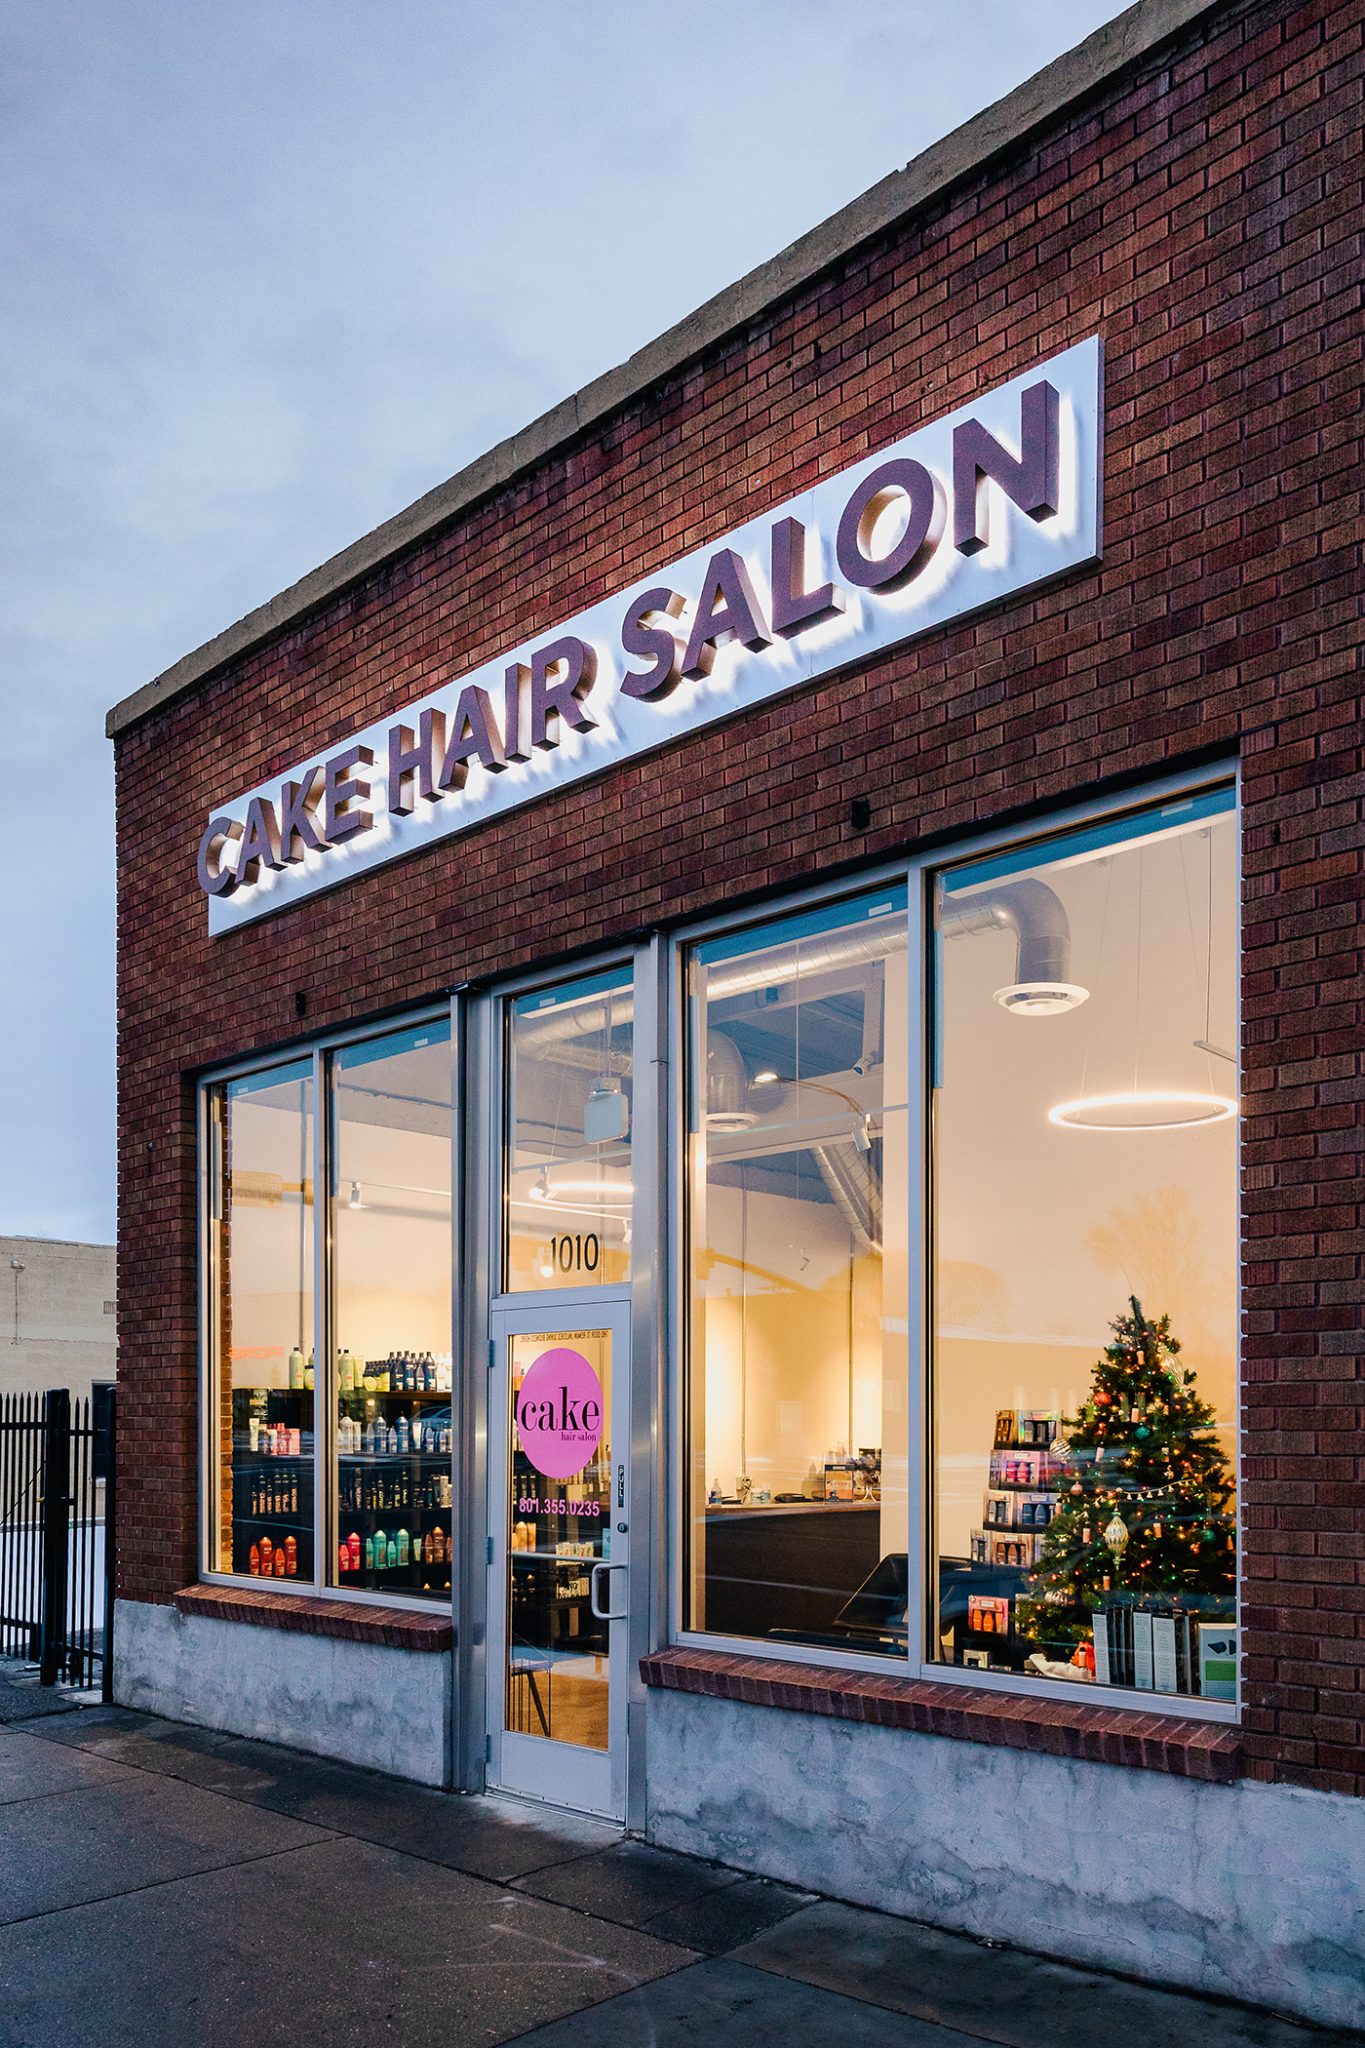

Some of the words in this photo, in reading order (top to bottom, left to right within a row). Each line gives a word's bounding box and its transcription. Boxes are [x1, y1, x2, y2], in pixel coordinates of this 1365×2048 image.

[197, 744, 375, 898] CAKE
[388, 635, 600, 818] HAIR
[619, 379, 1061, 703] SALON
[551, 1233, 599, 1273] 1010
[521, 1386, 600, 1431] cake
[561, 1431, 576, 1441] hair
[577, 1431, 597, 1441] salon
[519, 1497, 600, 1517] 801.355.0235
